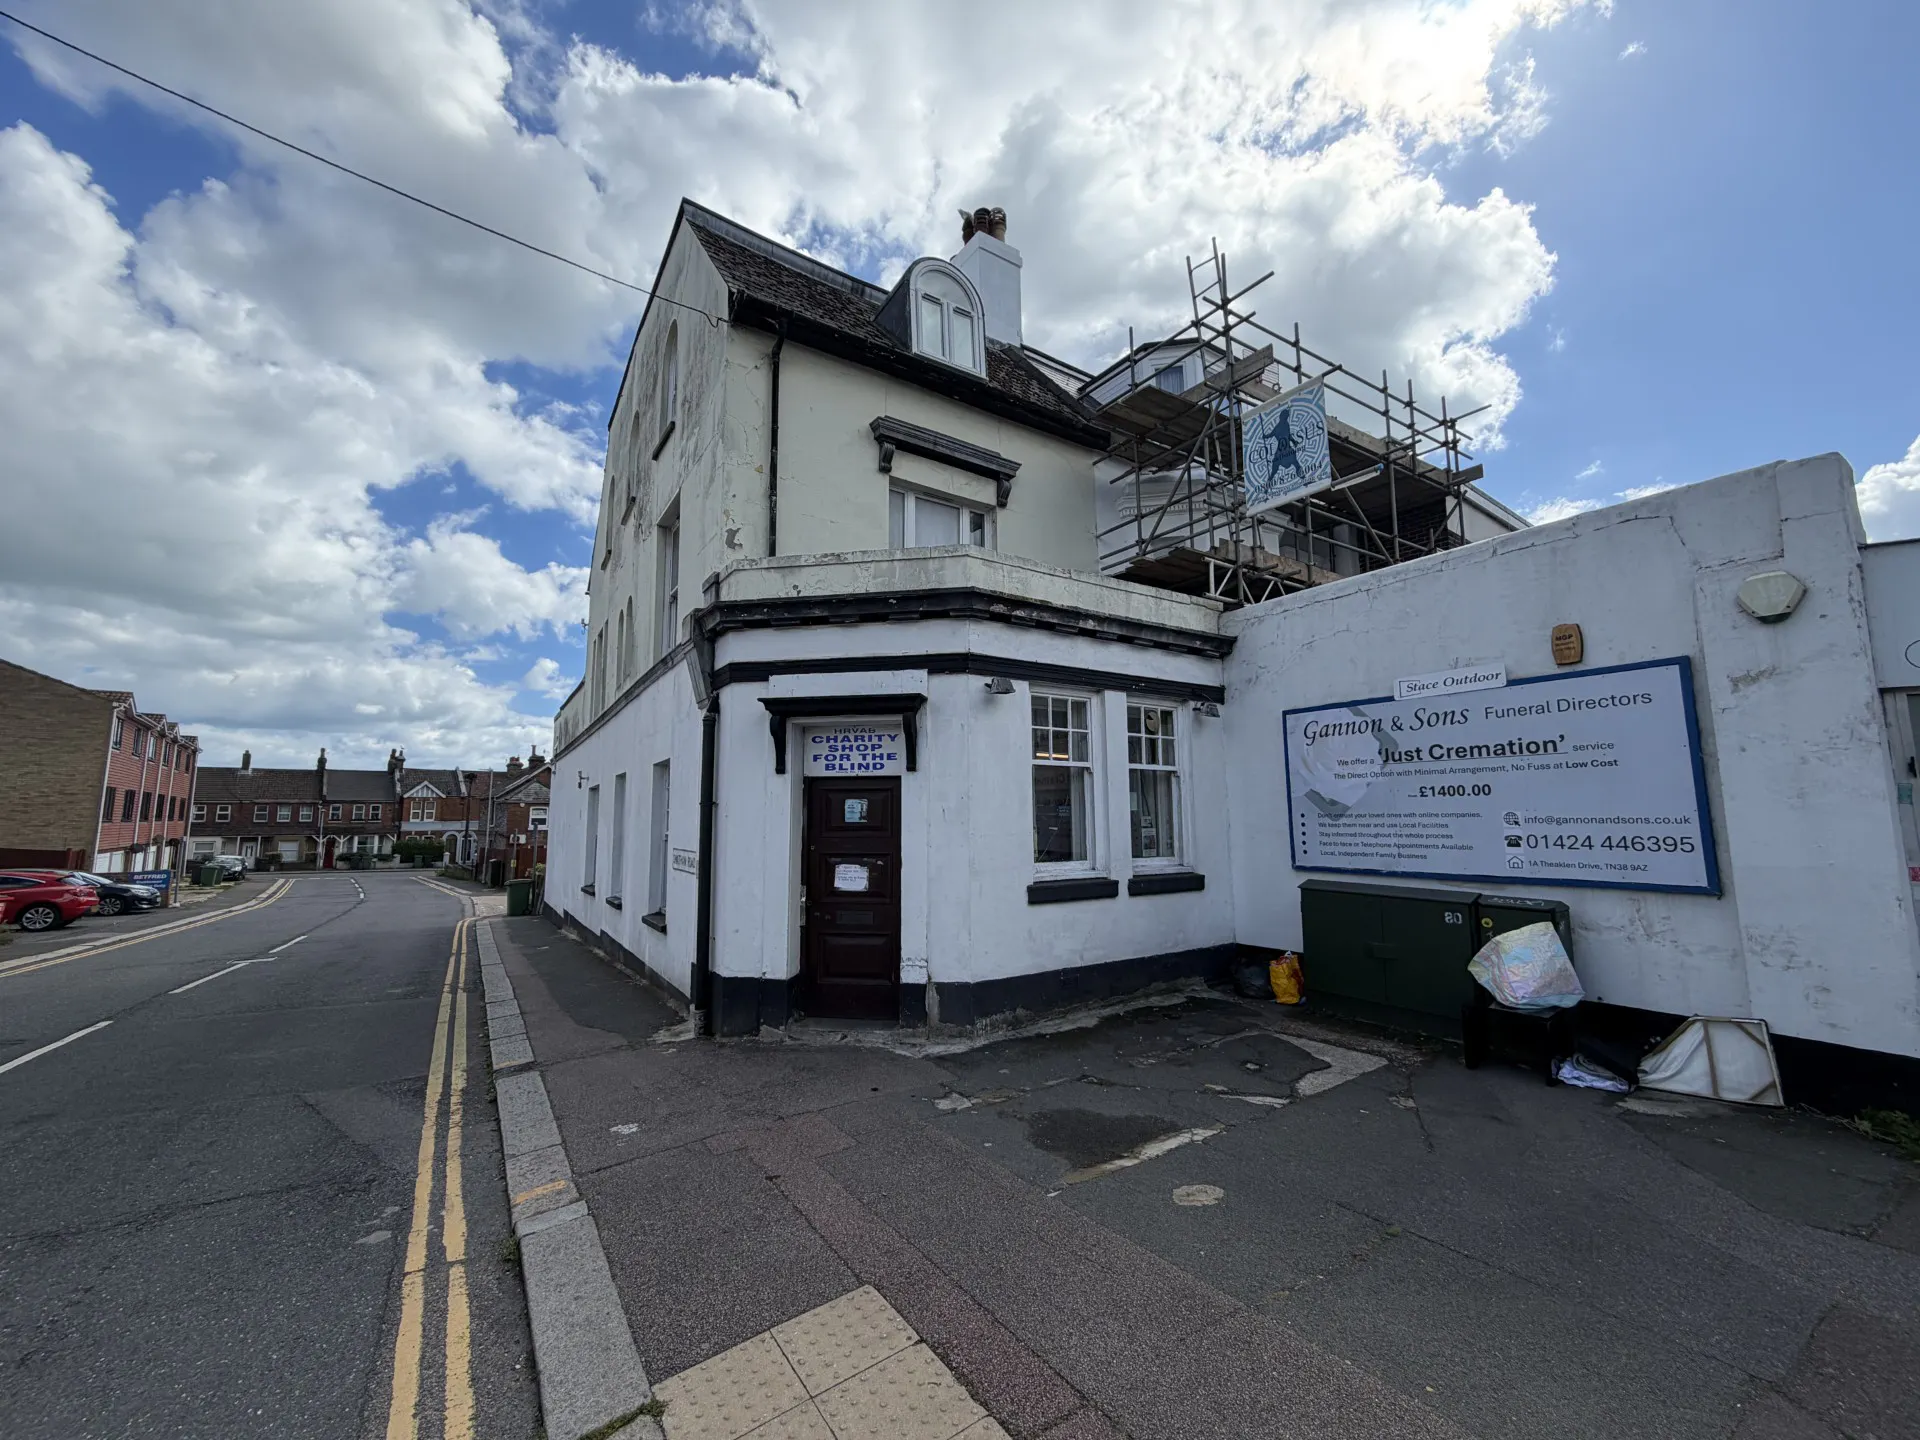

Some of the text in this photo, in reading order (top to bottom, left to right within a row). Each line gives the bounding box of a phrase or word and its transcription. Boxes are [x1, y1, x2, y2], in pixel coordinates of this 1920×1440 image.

[1406, 672, 1502, 693] Stace Outdoor
[1303, 692, 1653, 747] Gannon & Sons Funeral Directors
[811, 734, 899, 744] CHARITY
[828, 744, 883, 752] SHOP
[1572, 742, 1615, 752] service
[812, 752, 898, 762] FOR THE
[824, 762, 885, 771] BLIND
[1334, 772, 1346, 780] The
[1347, 771, 1368, 779] Direct
[1369, 770, 1394, 779] Option
[1396, 769, 1413, 777] with
[1414, 767, 1448, 775] Minimal
[1449, 765, 1509, 775] Arrangement,
[1511, 763, 1525, 772] No
[1527, 762, 1551, 771] Fuss
[1565, 760, 1588, 769] Low
[1590, 759, 1619, 768] Cost
[1419, 783, 1492, 798] £1400.00
[1524, 815, 1691, 826] info@gannonandsons.co.uk
[1360, 841, 1392, 849] Telephone
[1392, 842, 1440, 850] Appointments
[1440, 843, 1474, 851] Available
[1526, 834, 1695, 853] 01424 446395
[1375, 851, 1397, 859] Family
[1397, 852, 1428, 860] Business
[1578, 862, 1603, 871] Drive,
[1604, 862, 1629, 871] TN38
[1630, 864, 1649, 872] 9AZ
